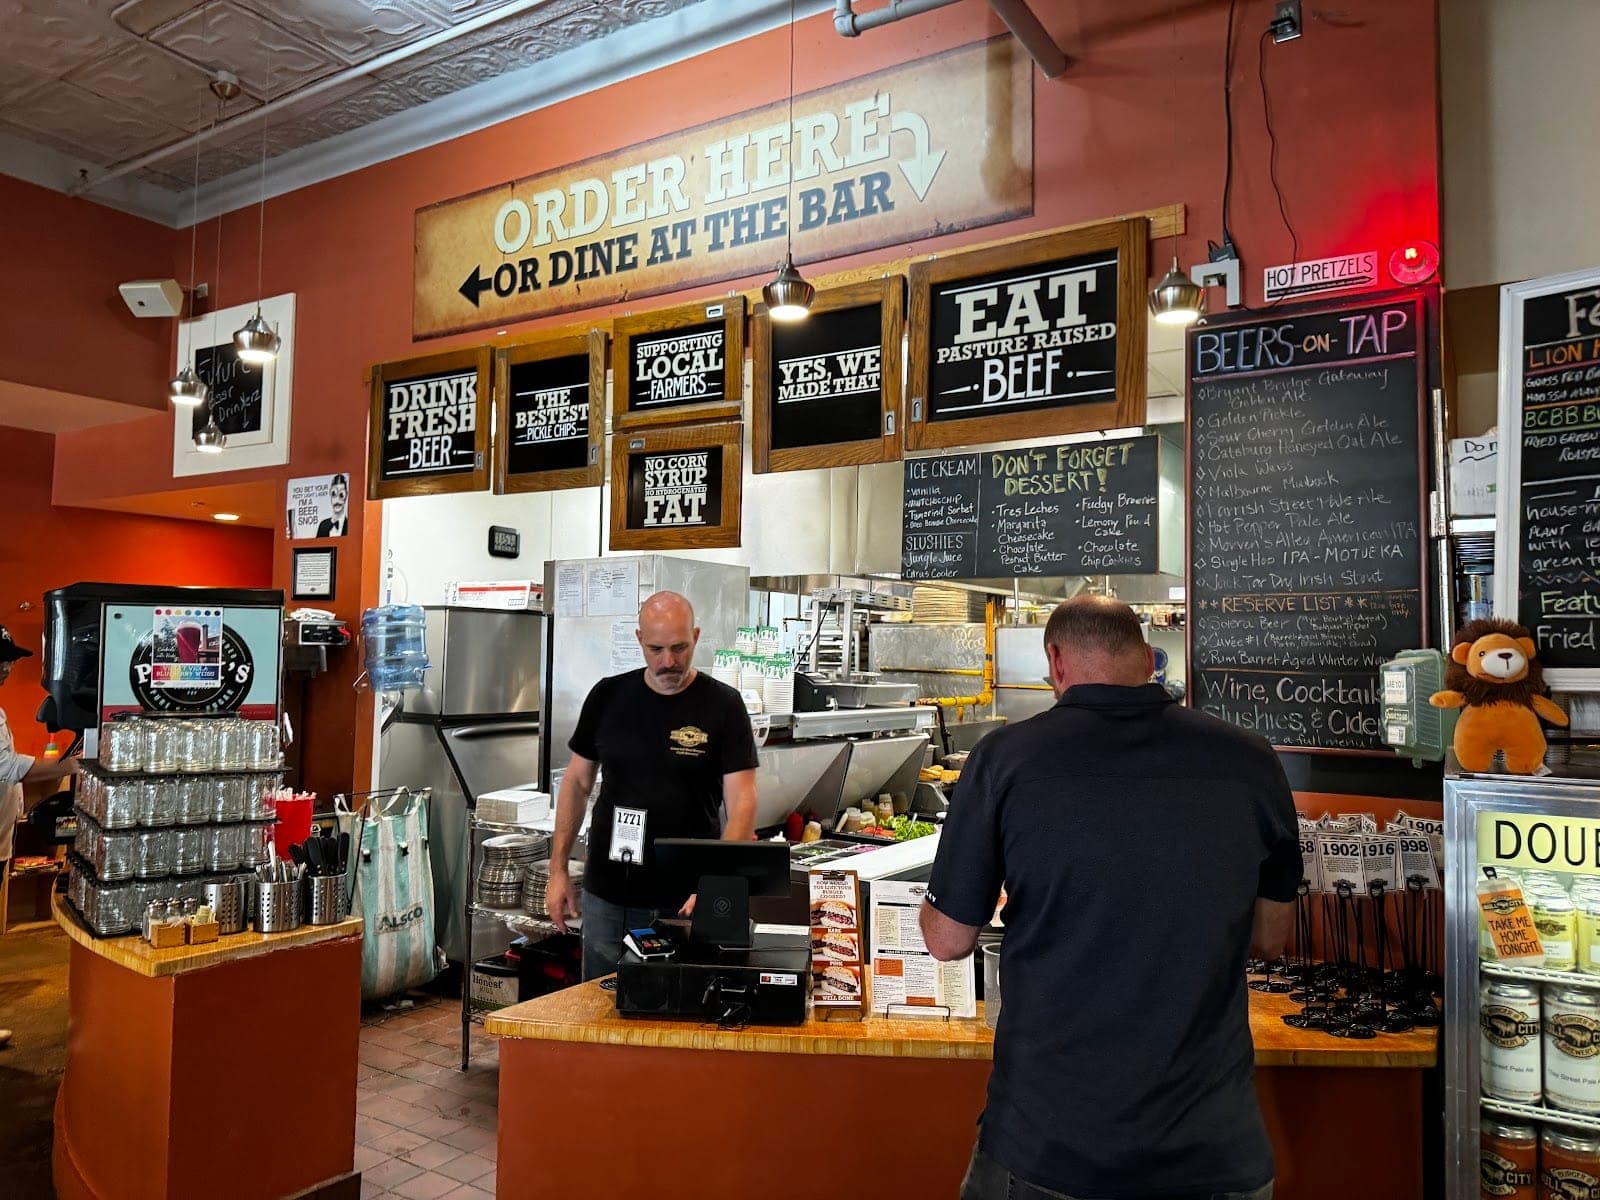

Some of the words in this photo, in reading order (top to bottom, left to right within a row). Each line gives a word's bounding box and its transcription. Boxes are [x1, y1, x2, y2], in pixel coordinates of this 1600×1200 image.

[493, 154, 691, 254] ORDER
[703, 93, 893, 205] HERE
[494, 259, 542, 300] OR
[547, 233, 639, 289] DINE
[646, 217, 696, 266] AT
[703, 198, 788, 253] THE
[798, 171, 895, 232] BAR
[1267, 267, 1297, 288] HOT
[1301, 255, 1374, 283] PRETZELS
[953, 269, 1097, 345] EAT
[637, 334, 723, 359] SUPPORTING
[937, 336, 1028, 364] PASTURE
[1032, 321, 1117, 347] RAISED
[1197, 324, 1295, 373] BEERS
[1339, 309, 1407, 354] TAP
[1530, 342, 1583, 368] LION
[636, 348, 724, 381] LOCAL
[778, 361, 833, 387] YES,
[836, 349, 881, 376] WE
[982, 348, 1064, 403] BEEF
[389, 375, 478, 413] DRINK
[651, 373, 707, 400] FARMERS
[778, 380, 831, 401] MADE
[833, 372, 881, 393] THAT
[535, 389, 571, 410] THE
[388, 402, 477, 441] FRESH
[515, 403, 590, 429] BESTEST
[1208, 411, 1258, 428] Golden
[1524, 405, 1579, 428] BCBB
[527, 425, 552, 440] PICKLE
[553, 422, 577, 438] CHIPS
[1207, 431, 1241, 445] Sour
[1248, 427, 1295, 443] Cherry
[1301, 418, 1354, 435] Golden
[1357, 413, 1389, 430] Ale
[1560, 431, 1599, 445] GREEN
[409, 435, 452, 469] BEER
[1279, 434, 1334, 457] Honeyed
[1371, 431, 1403, 448] Ale
[645, 459, 665, 471] NO
[668, 455, 708, 469] CORN
[910, 462, 928, 479] ICE
[931, 458, 977, 478] CREAM
[992, 450, 1047, 479] DON'T
[1056, 443, 1135, 471] FORGET
[644, 467, 708, 488] SYRUP
[1208, 463, 1248, 481] Viola
[1255, 462, 1294, 475] Weiss
[315, 484, 329, 492] YOUR
[298, 506, 318, 516] BEER
[644, 493, 707, 524] FAT
[947, 502, 974, 516] Sorbet
[996, 504, 1022, 518] Tres
[1024, 501, 1060, 516] Leches
[1082, 496, 1114, 515] Fudgy
[1269, 498, 1314, 513] Street
[298, 516, 318, 526] SNOB
[997, 516, 1046, 534] Margarita
[1082, 516, 1118, 531] Lemony
[1209, 519, 1231, 535] Hot
[1233, 517, 1280, 539] Pepper
[1285, 512, 1321, 528] Pale
[1327, 511, 1355, 526] Ale
[998, 531, 1055, 545] Cheesecake
[1095, 529, 1124, 537] Cake
[1529, 524, 1571, 539] PLANT
[906, 534, 964, 551] SLUSHIES
[1000, 542, 1048, 555] Chocolate
[1084, 539, 1140, 553] Chocolate
[1528, 538, 1571, 551] with
[904, 552, 938, 570] Jungle
[939, 550, 963, 564] Juice
[1001, 554, 1030, 565] Peanut
[1034, 552, 1067, 563] Butter
[1081, 555, 1101, 568] Chip
[1210, 555, 1248, 572] Single
[1283, 550, 1310, 565] IPA
[1325, 544, 1404, 563] MOTUEKA
[1532, 556, 1583, 573] green
[906, 568, 930, 578] Citrus
[931, 568, 959, 578] Cooler
[1013, 564, 1043, 573] Cake
[1269, 573, 1293, 591] Dry
[1300, 572, 1334, 587] Irish
[1341, 568, 1383, 586] Stout
[1222, 597, 1296, 613] RESERVE
[1303, 596, 1338, 612] LIST
[1260, 616, 1291, 631] Beer
[1536, 622, 1595, 650] Fried
[1210, 650, 1237, 663] Rum
[1319, 653, 1359, 665] Winter
[1201, 672, 1269, 704] Wine,
[1293, 732, 1320, 747] full
[617, 811, 642, 827] 1771
[1407, 820, 1444, 835] 1904
[1322, 843, 1360, 857] 1902
[1362, 843, 1395, 857] 1916
[1496, 820, 1600, 867] DOU
[379, 907, 423, 930] ALSCO
[1488, 917, 1516, 931] TAKE
[1515, 916, 1532, 928] ME
[1500, 929, 1529, 943] HOME
[1497, 940, 1540, 957] TONIGHT
[473, 974, 503, 989] Honest
[1506, 1172, 1532, 1185] CITY
